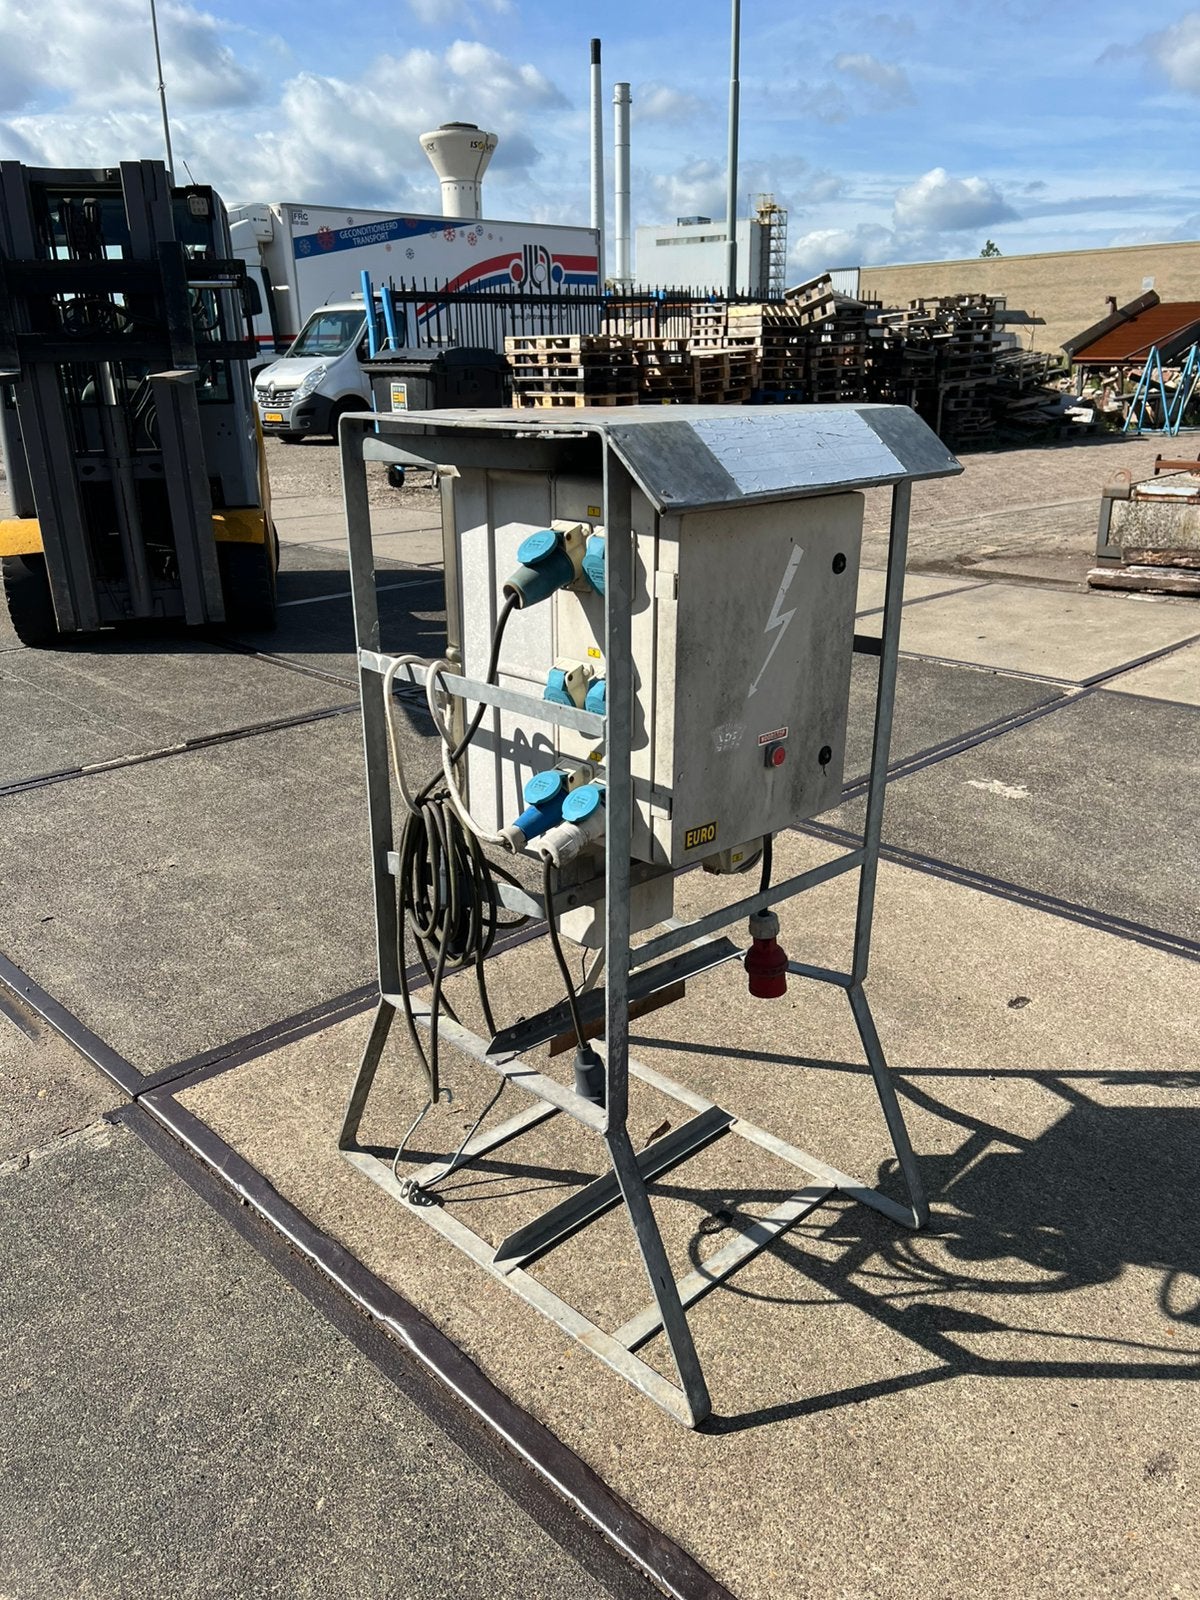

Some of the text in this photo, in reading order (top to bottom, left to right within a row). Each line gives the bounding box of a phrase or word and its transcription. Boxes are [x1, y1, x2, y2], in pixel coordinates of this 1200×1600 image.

[294, 213, 308, 221] FRC
[340, 221, 398, 239] GECONDITIONEERD
[353, 232, 389, 246] TRANSPORT
[686, 824, 715, 848] EURO
